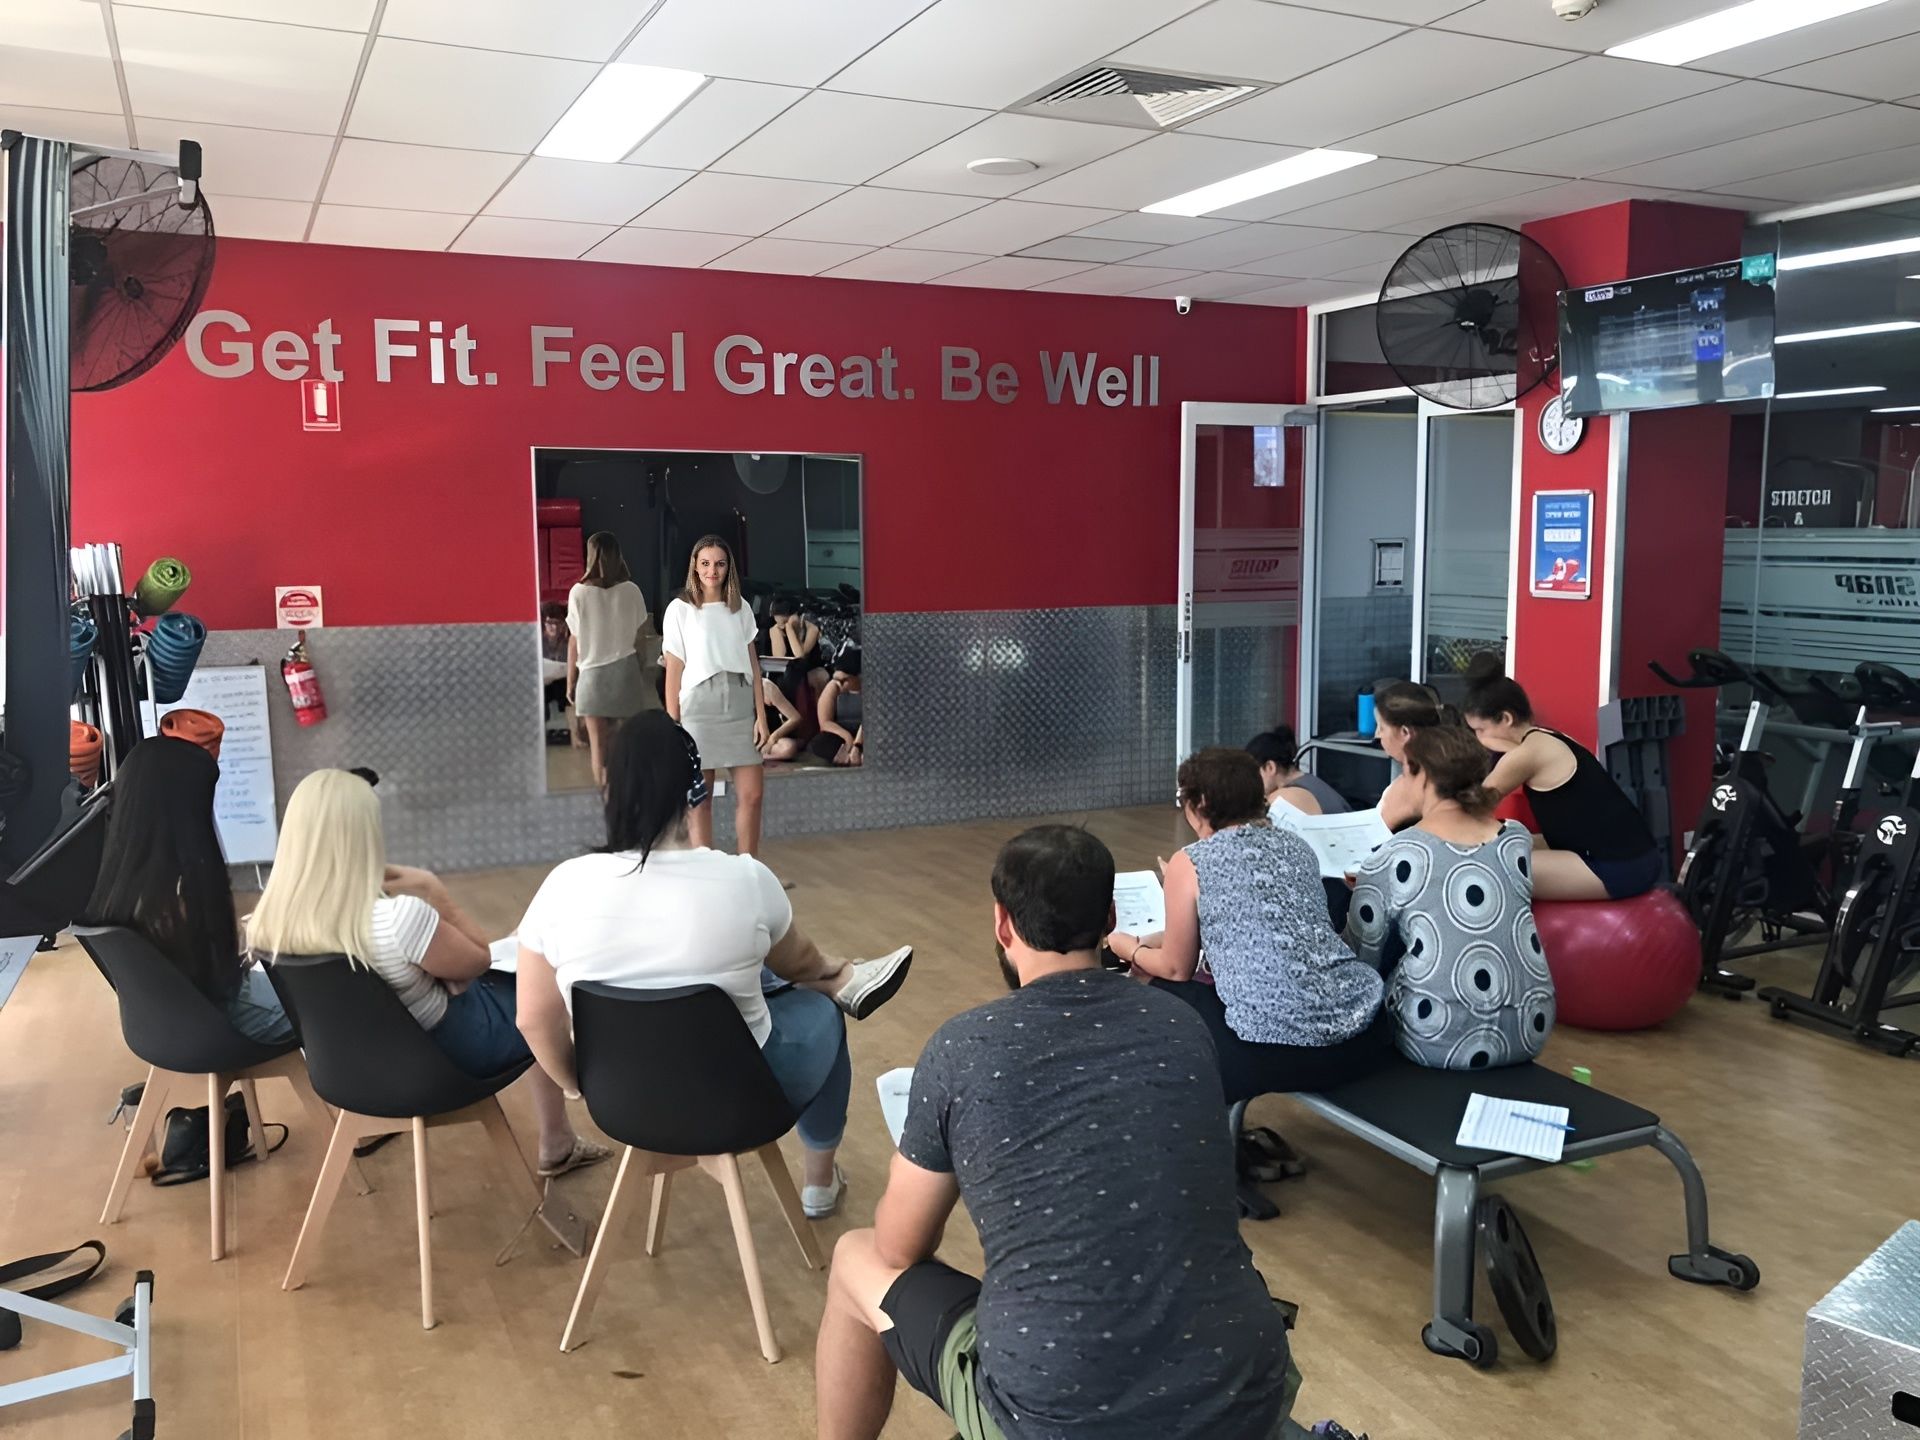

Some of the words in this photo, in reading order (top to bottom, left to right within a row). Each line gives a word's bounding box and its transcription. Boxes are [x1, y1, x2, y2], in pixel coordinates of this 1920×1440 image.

[185, 309, 345, 382] Get
[374, 318, 498, 387] Fit.
[530, 325, 686, 392] Feel
[713, 334, 915, 400] Great.
[941, 345, 1020, 405] Be
[1039, 350, 1159, 408] Well
